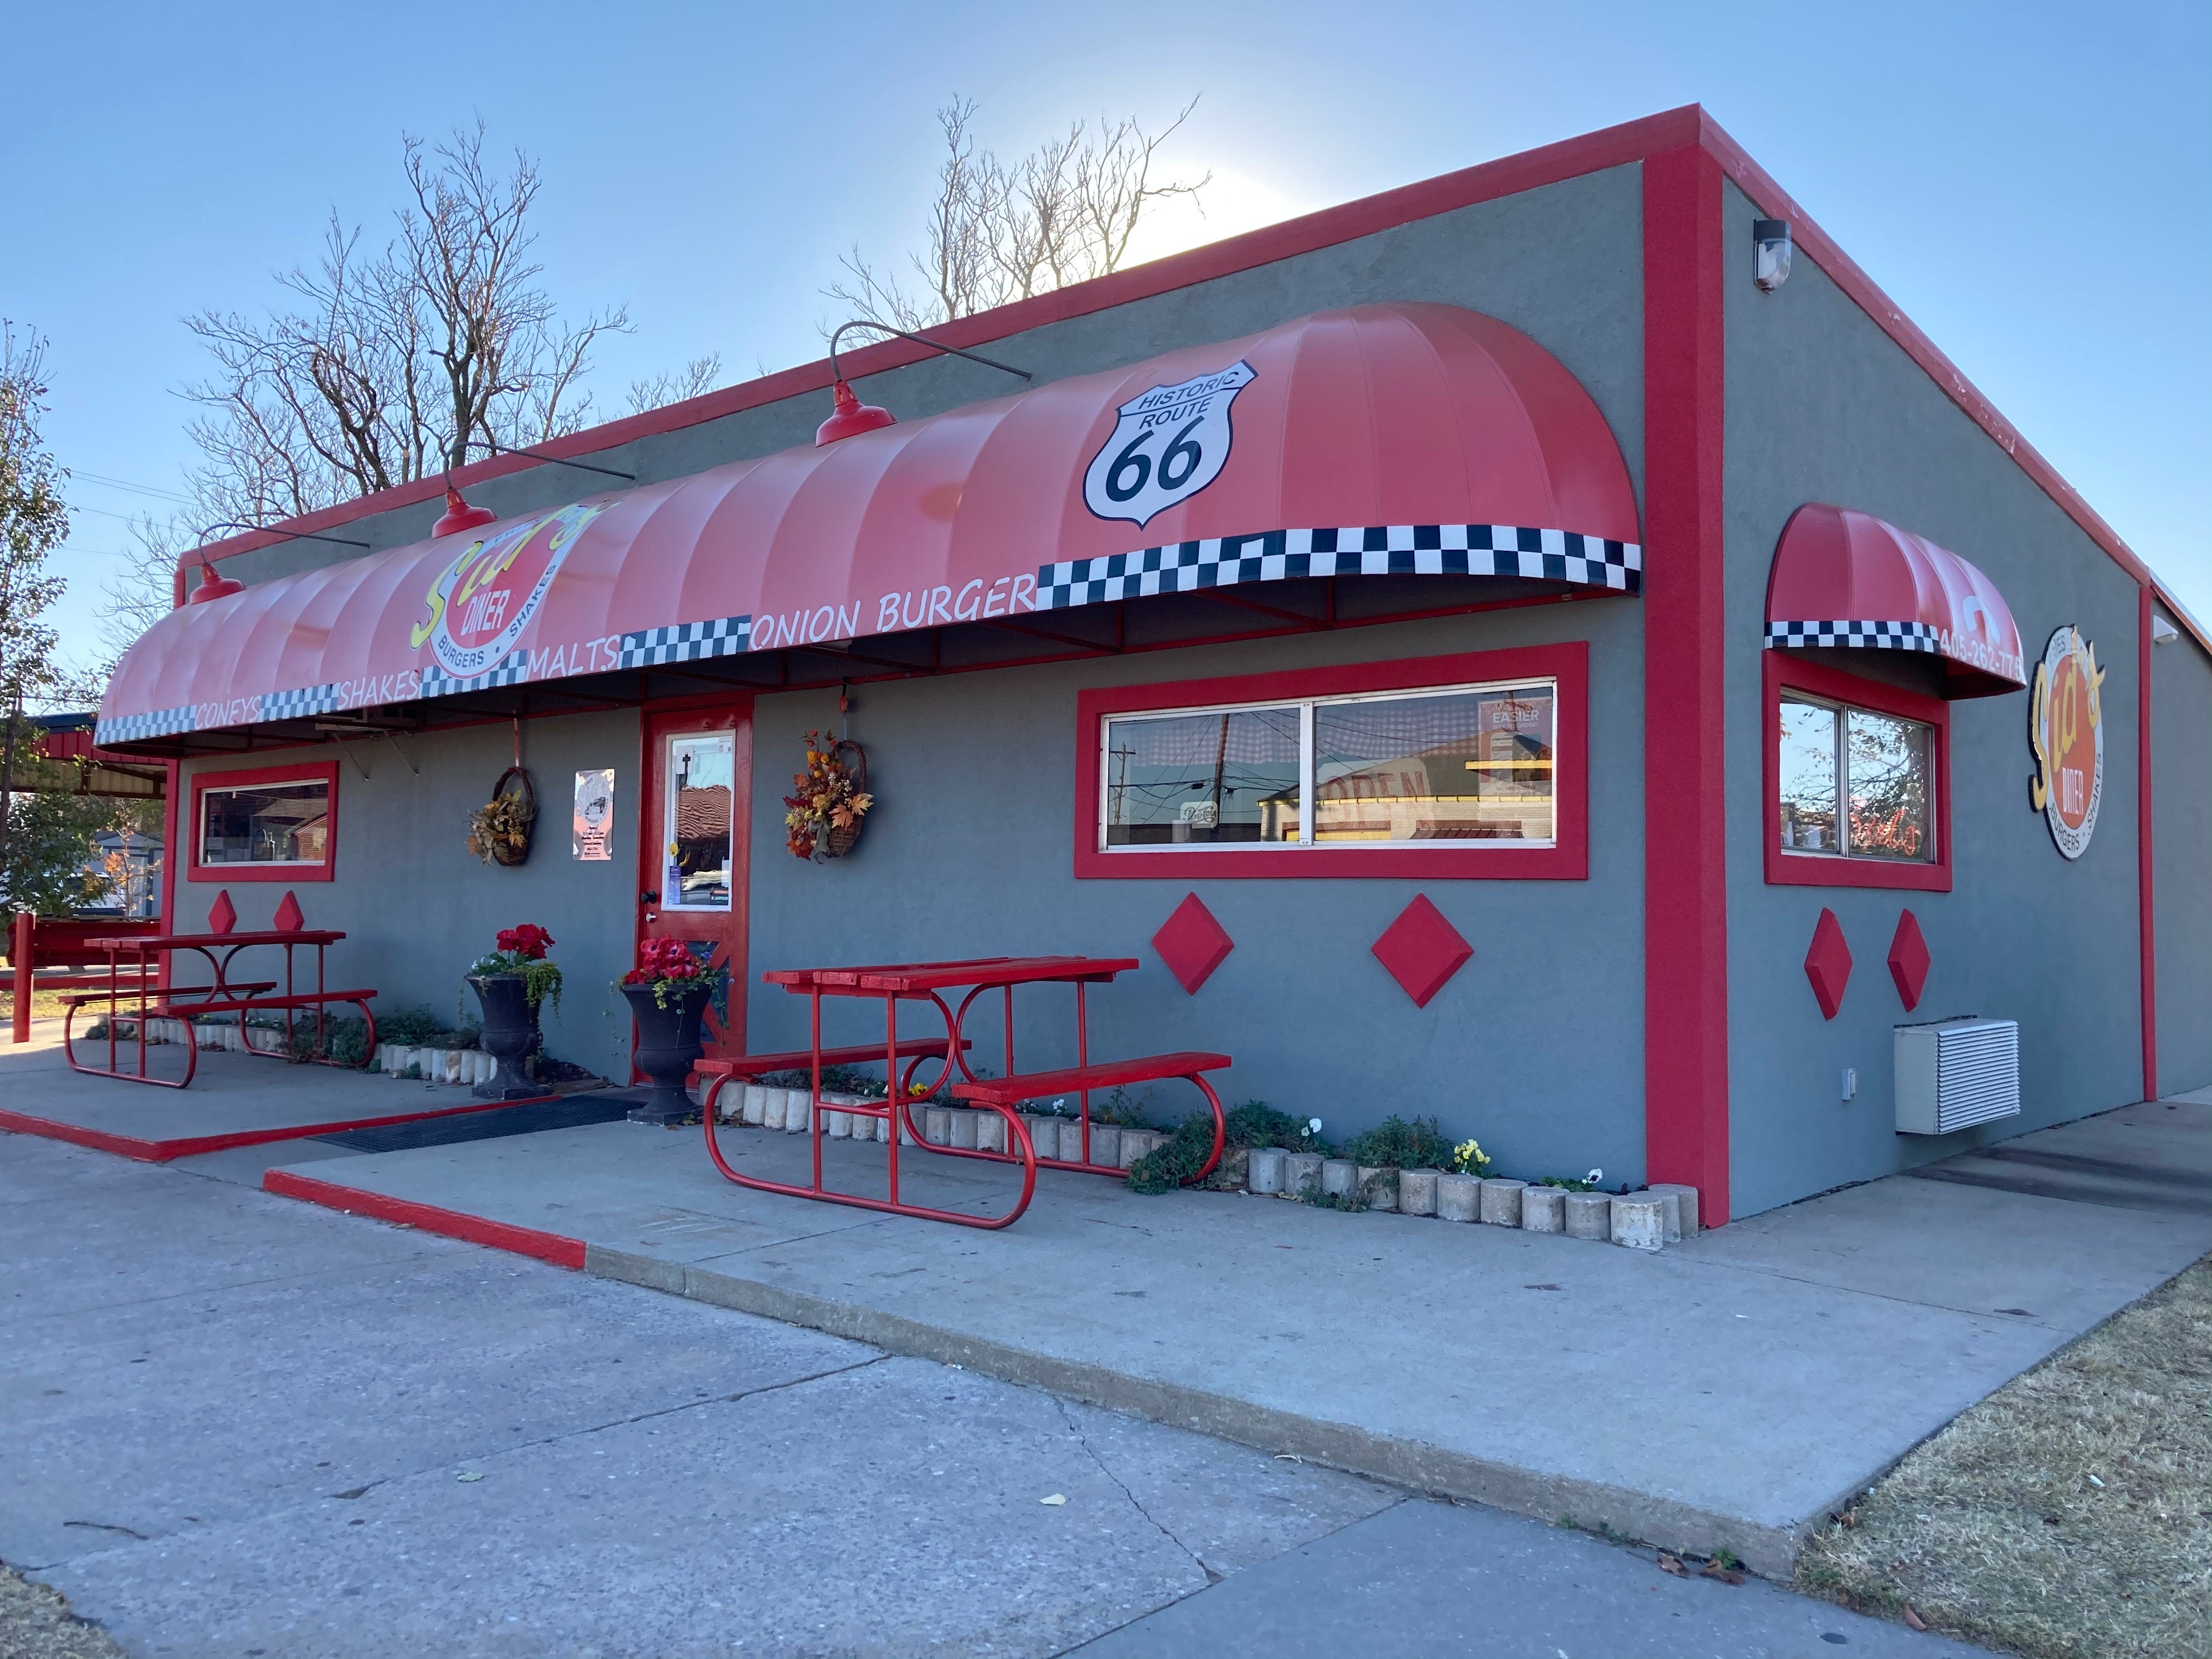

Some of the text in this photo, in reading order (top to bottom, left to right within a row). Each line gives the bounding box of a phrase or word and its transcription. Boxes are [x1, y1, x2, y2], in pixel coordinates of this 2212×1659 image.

[1138, 371, 1239, 410] HISTORIC
[1138, 396, 1214, 430] ROUTE
[1105, 415, 1205, 502] 66
[460, 589, 511, 636] DINER
[509, 565, 556, 637] SHAKES
[750, 573, 1036, 651] ONION BURGER
[438, 635, 484, 668] BURGERS
[525, 634, 621, 682] MALTS
[194, 695, 262, 730] CONEYS
[337, 670, 421, 709] SHAKES
[2029, 624, 2106, 812] Sid's
[1323, 771, 1435, 828] OPEN
[2062, 767, 2084, 815] DINER
[2087, 752, 2102, 829] SHAKES
[2050, 802, 2080, 852] BURGERS
